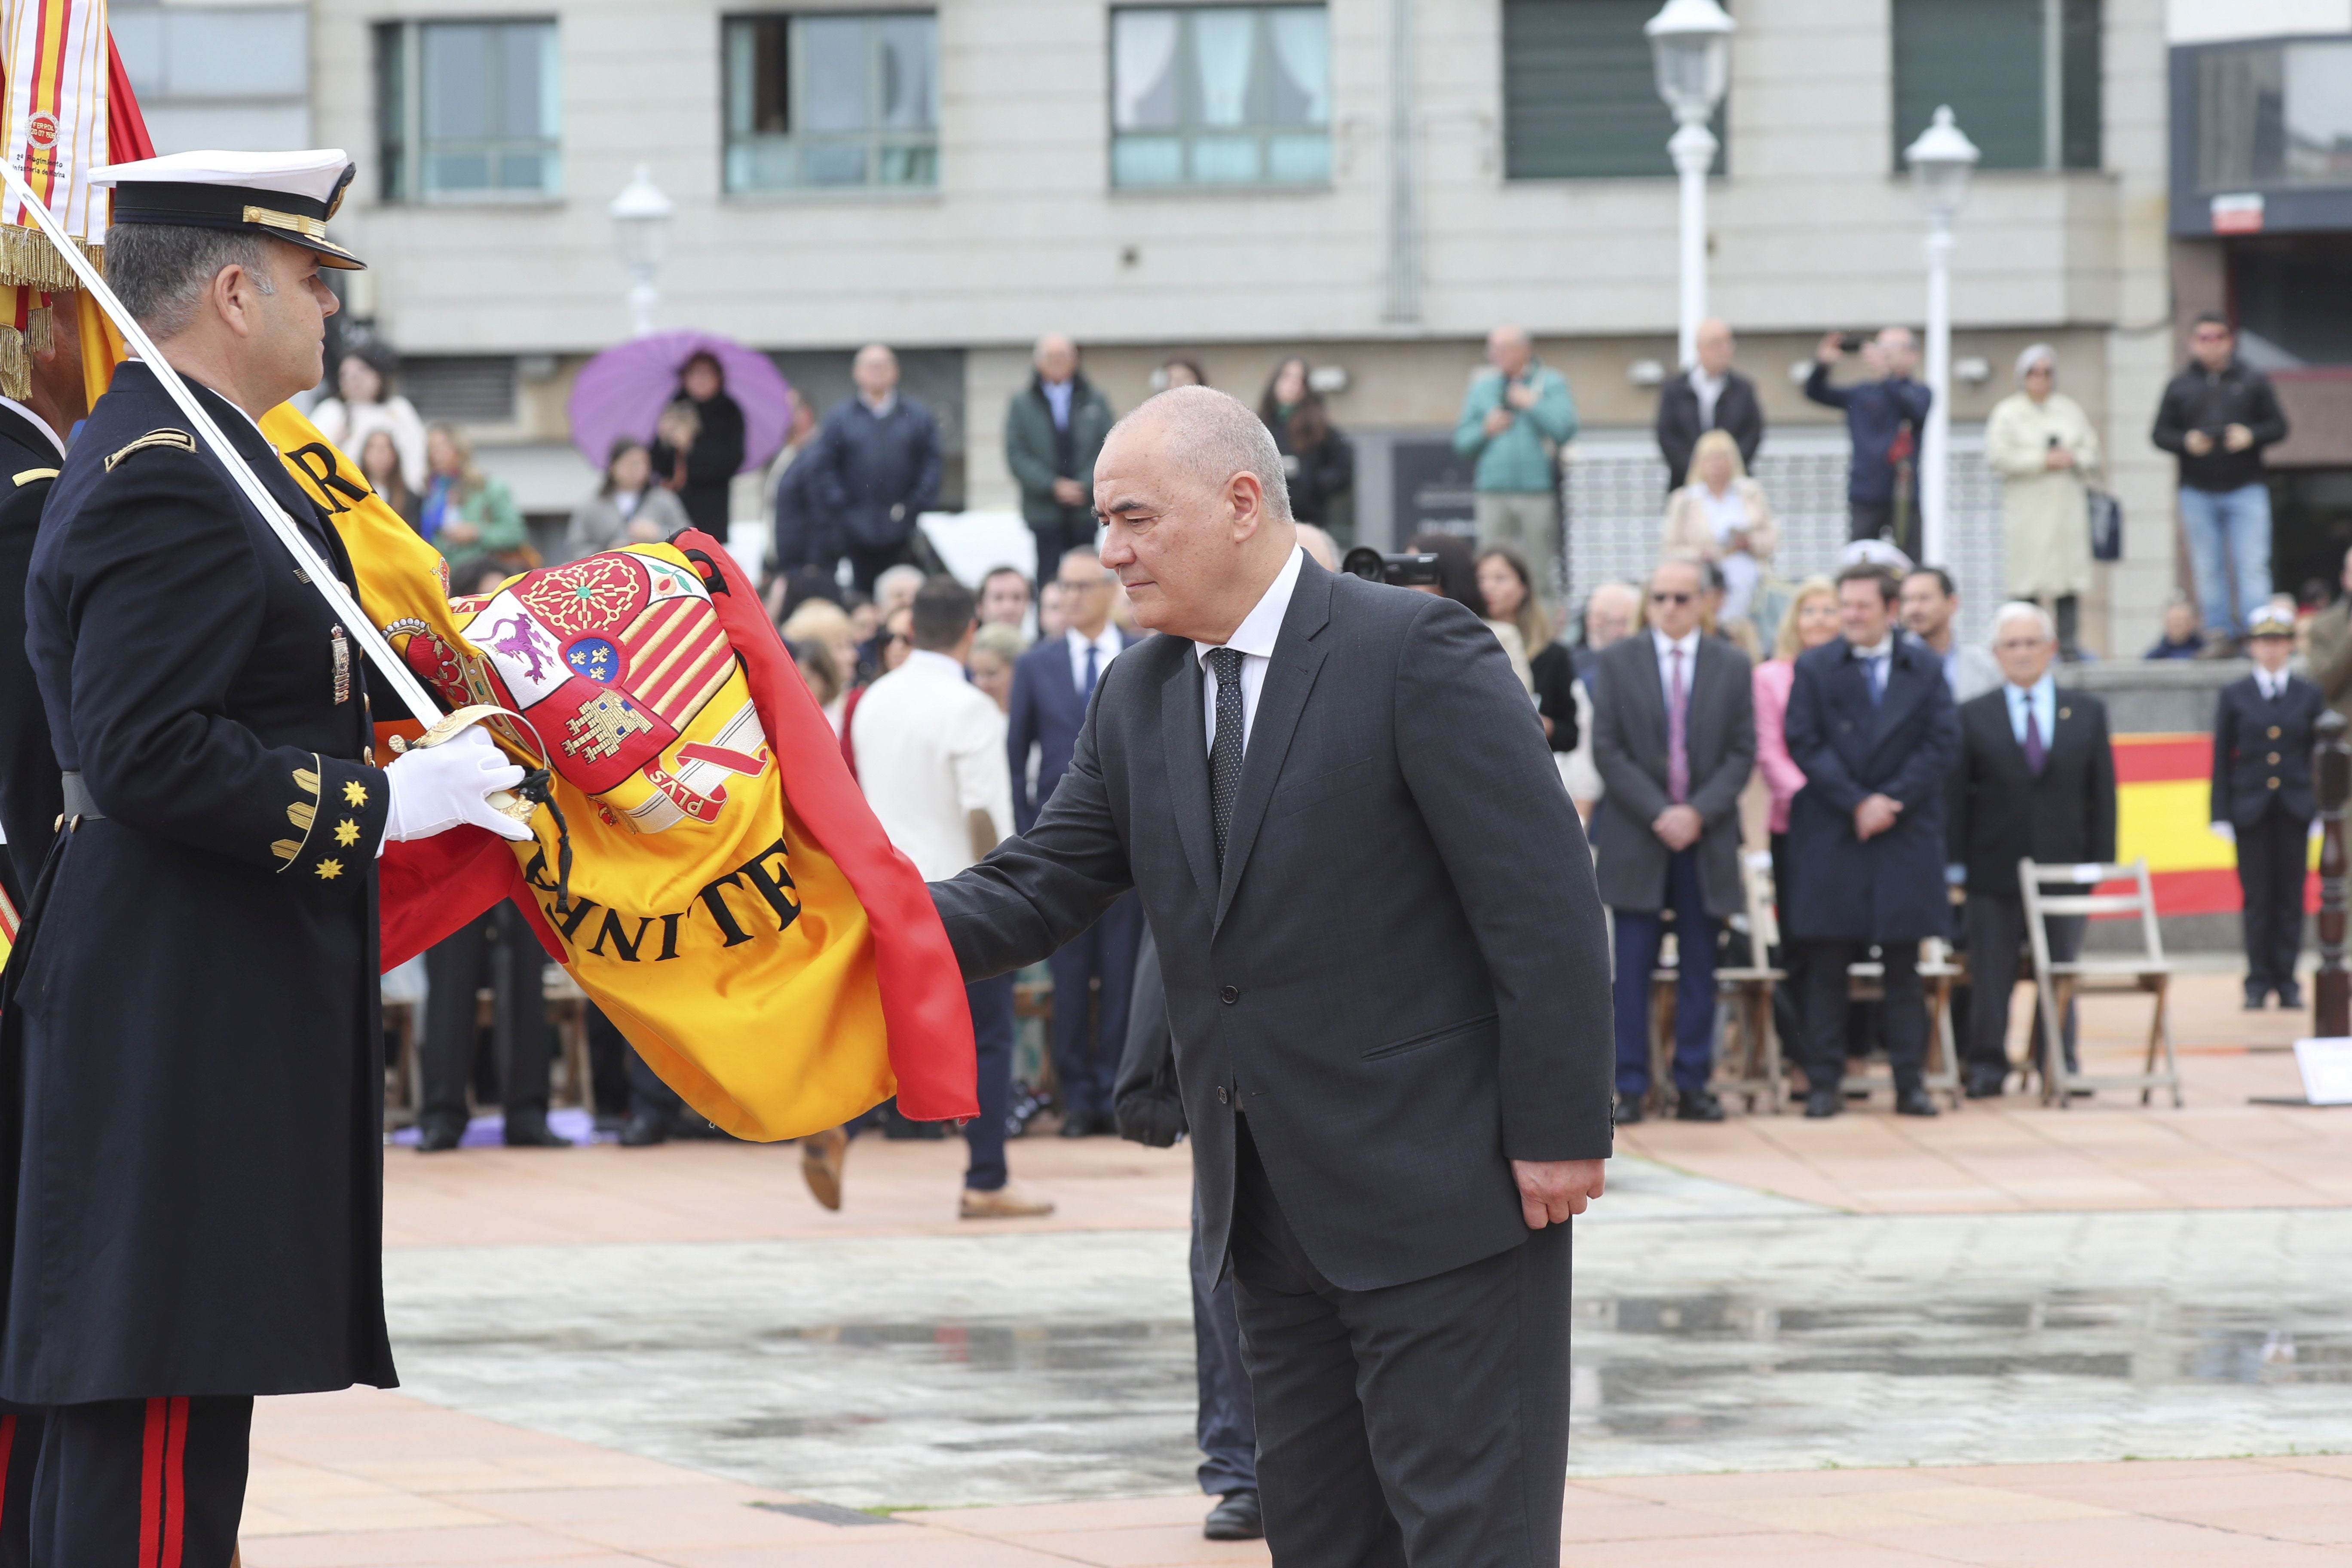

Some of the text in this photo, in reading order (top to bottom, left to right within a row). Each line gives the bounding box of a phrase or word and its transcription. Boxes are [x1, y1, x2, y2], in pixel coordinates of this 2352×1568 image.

[33, 122, 54, 131] FERROL
[27, 155, 63, 168] Regimiento
[48, 170, 65, 178] Marina
[649, 770, 704, 816] PLVS
